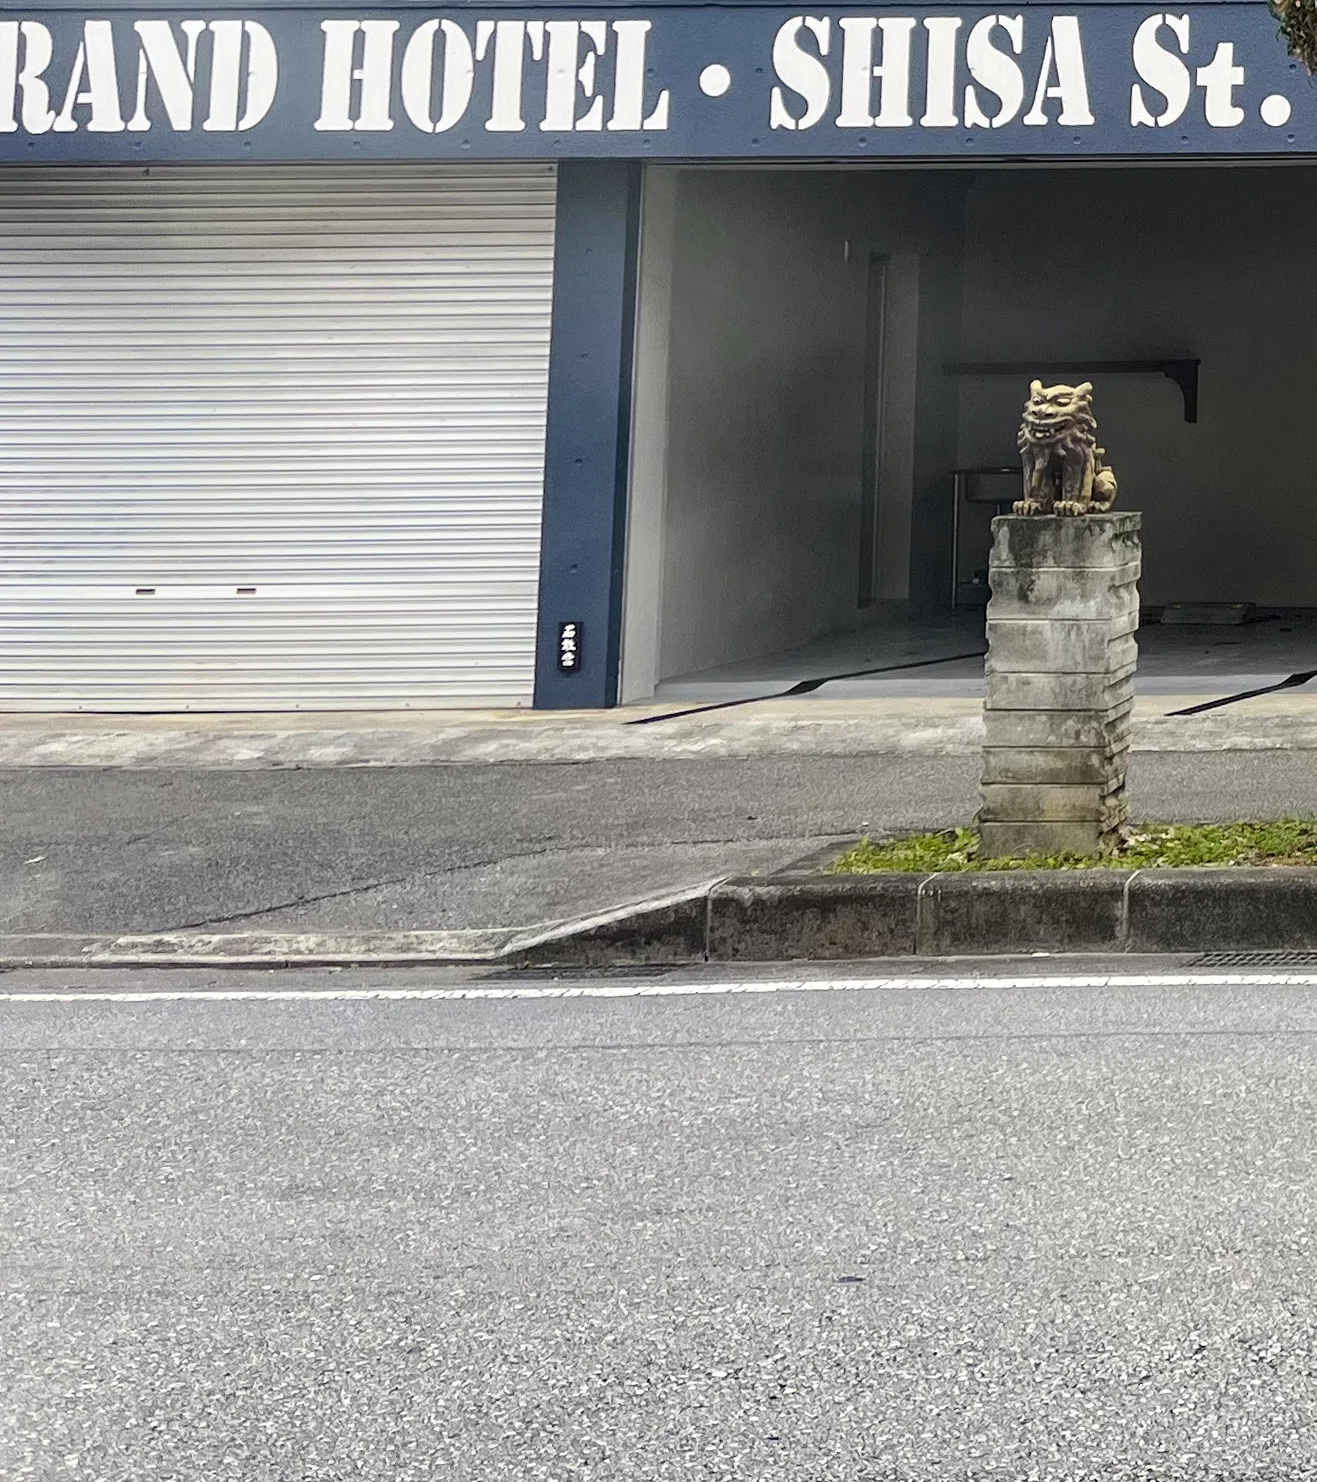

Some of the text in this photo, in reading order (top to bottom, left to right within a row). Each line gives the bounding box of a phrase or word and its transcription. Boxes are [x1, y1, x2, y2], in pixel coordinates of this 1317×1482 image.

[313, 18, 670, 134] HOTEL
[770, 14, 1095, 130] SHISA
[1130, 12, 1292, 128] St.
